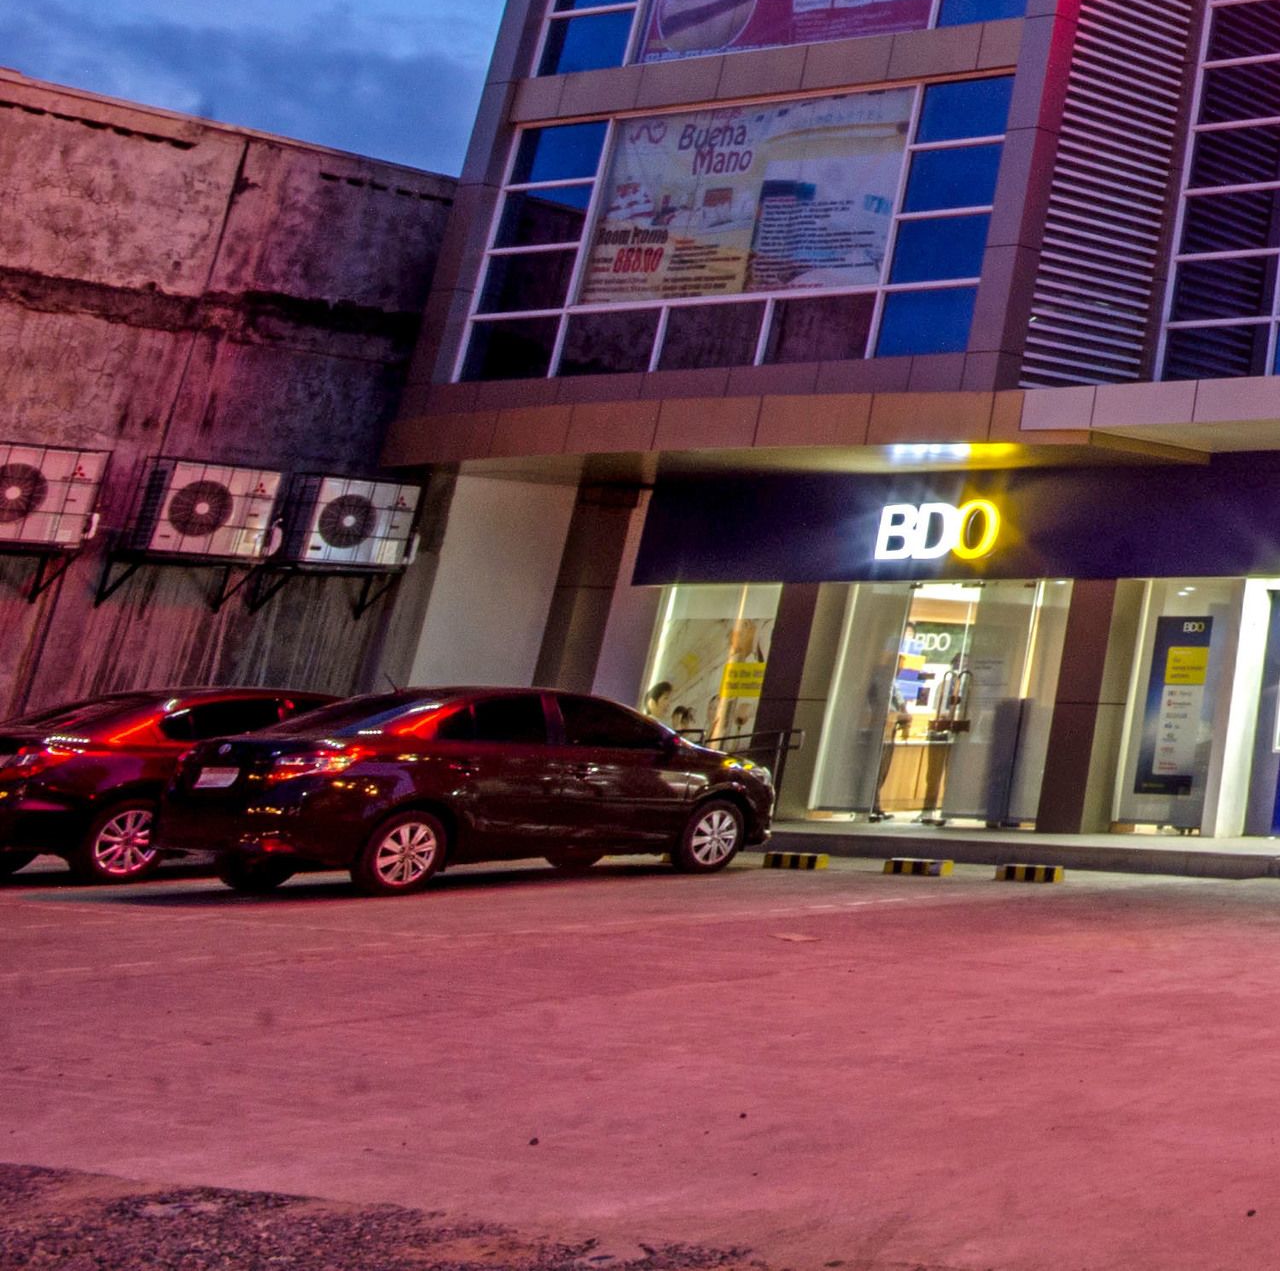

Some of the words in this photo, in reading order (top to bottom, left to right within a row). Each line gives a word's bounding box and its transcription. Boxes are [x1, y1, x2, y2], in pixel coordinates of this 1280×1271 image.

[678, 123, 748, 151] Buena
[692, 147, 753, 175] Mano
[874, 499, 1000, 560] BDO
[1183, 622, 1204, 632] BDO
[915, 633, 951, 651] BDO
